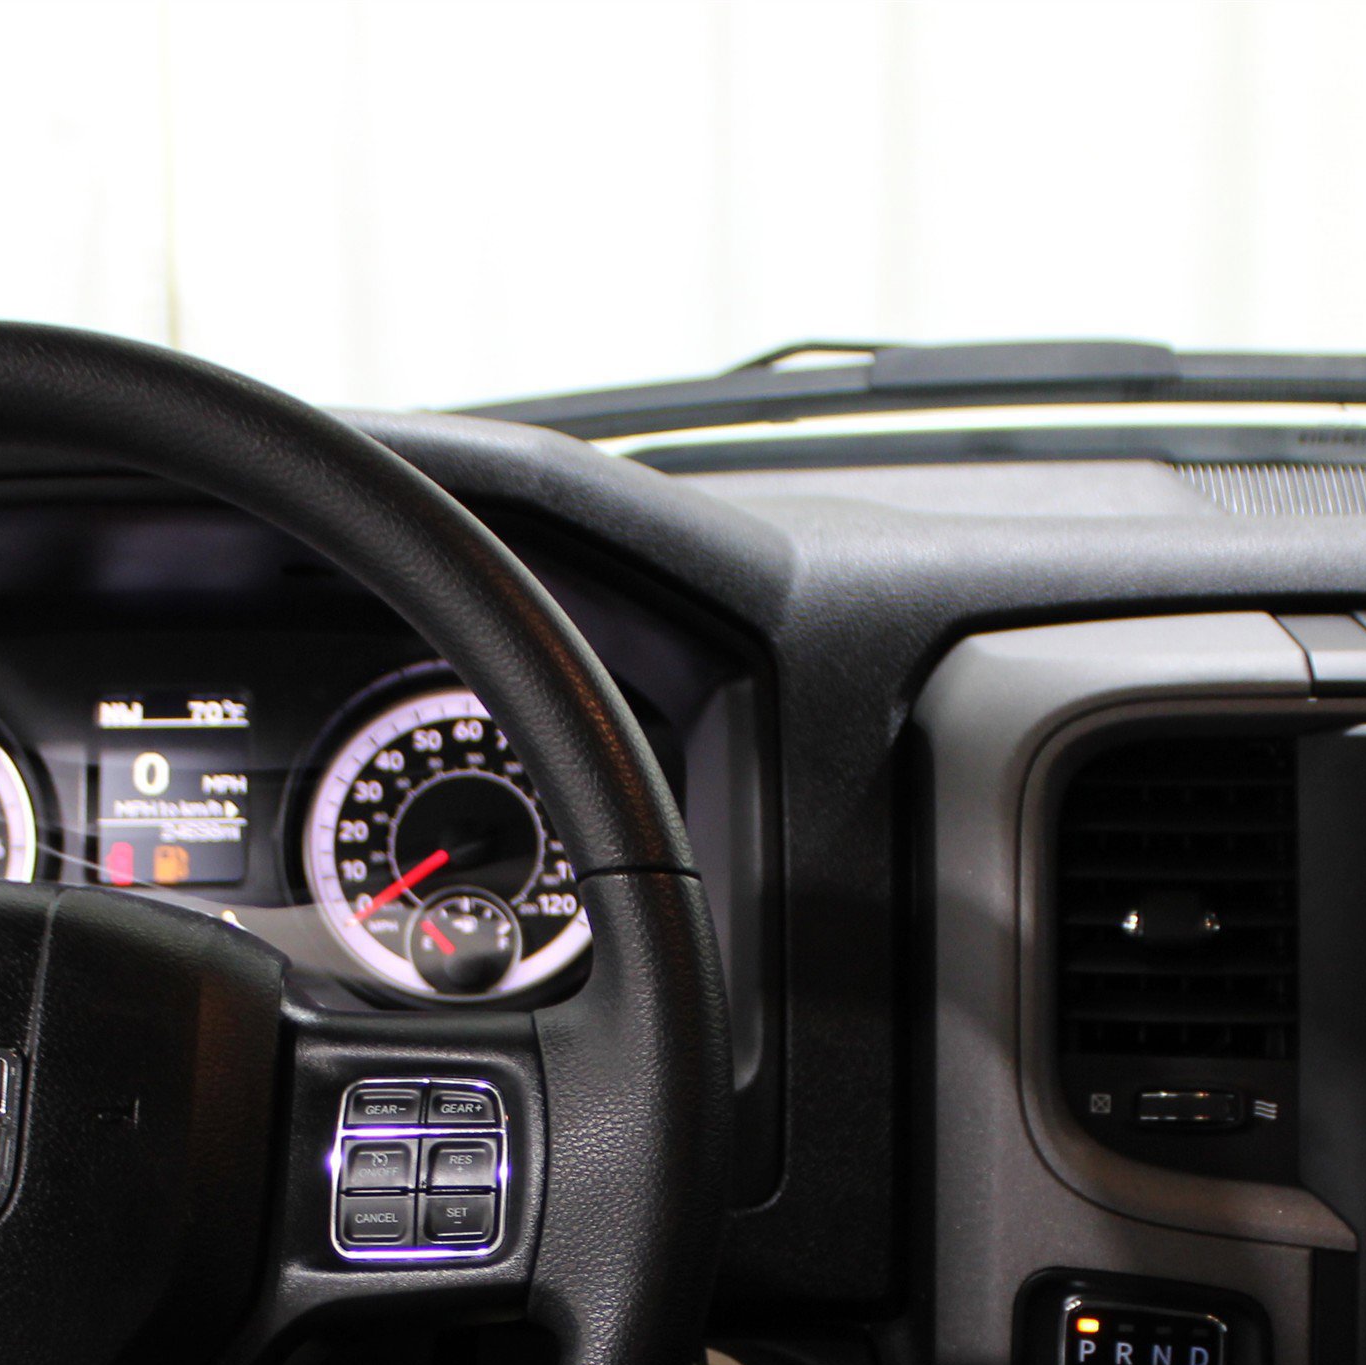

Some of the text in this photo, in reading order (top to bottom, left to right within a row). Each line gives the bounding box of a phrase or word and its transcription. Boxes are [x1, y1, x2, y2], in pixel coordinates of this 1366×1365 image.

[413, 728, 443, 752] 50
[452, 719, 484, 741] 60
[375, 750, 405, 772] 40
[133, 751, 248, 796] 0 MPH
[354, 780, 384, 803] 30
[339, 820, 369, 842] 20
[340, 859, 367, 882] 10
[538, 893, 578, 916] 120
[449, 1154, 474, 1166] RES
[354, 1212, 399, 1225] CANCEL
[446, 1206, 469, 1218] SET
[1077, 1339, 1097, 1364] P
